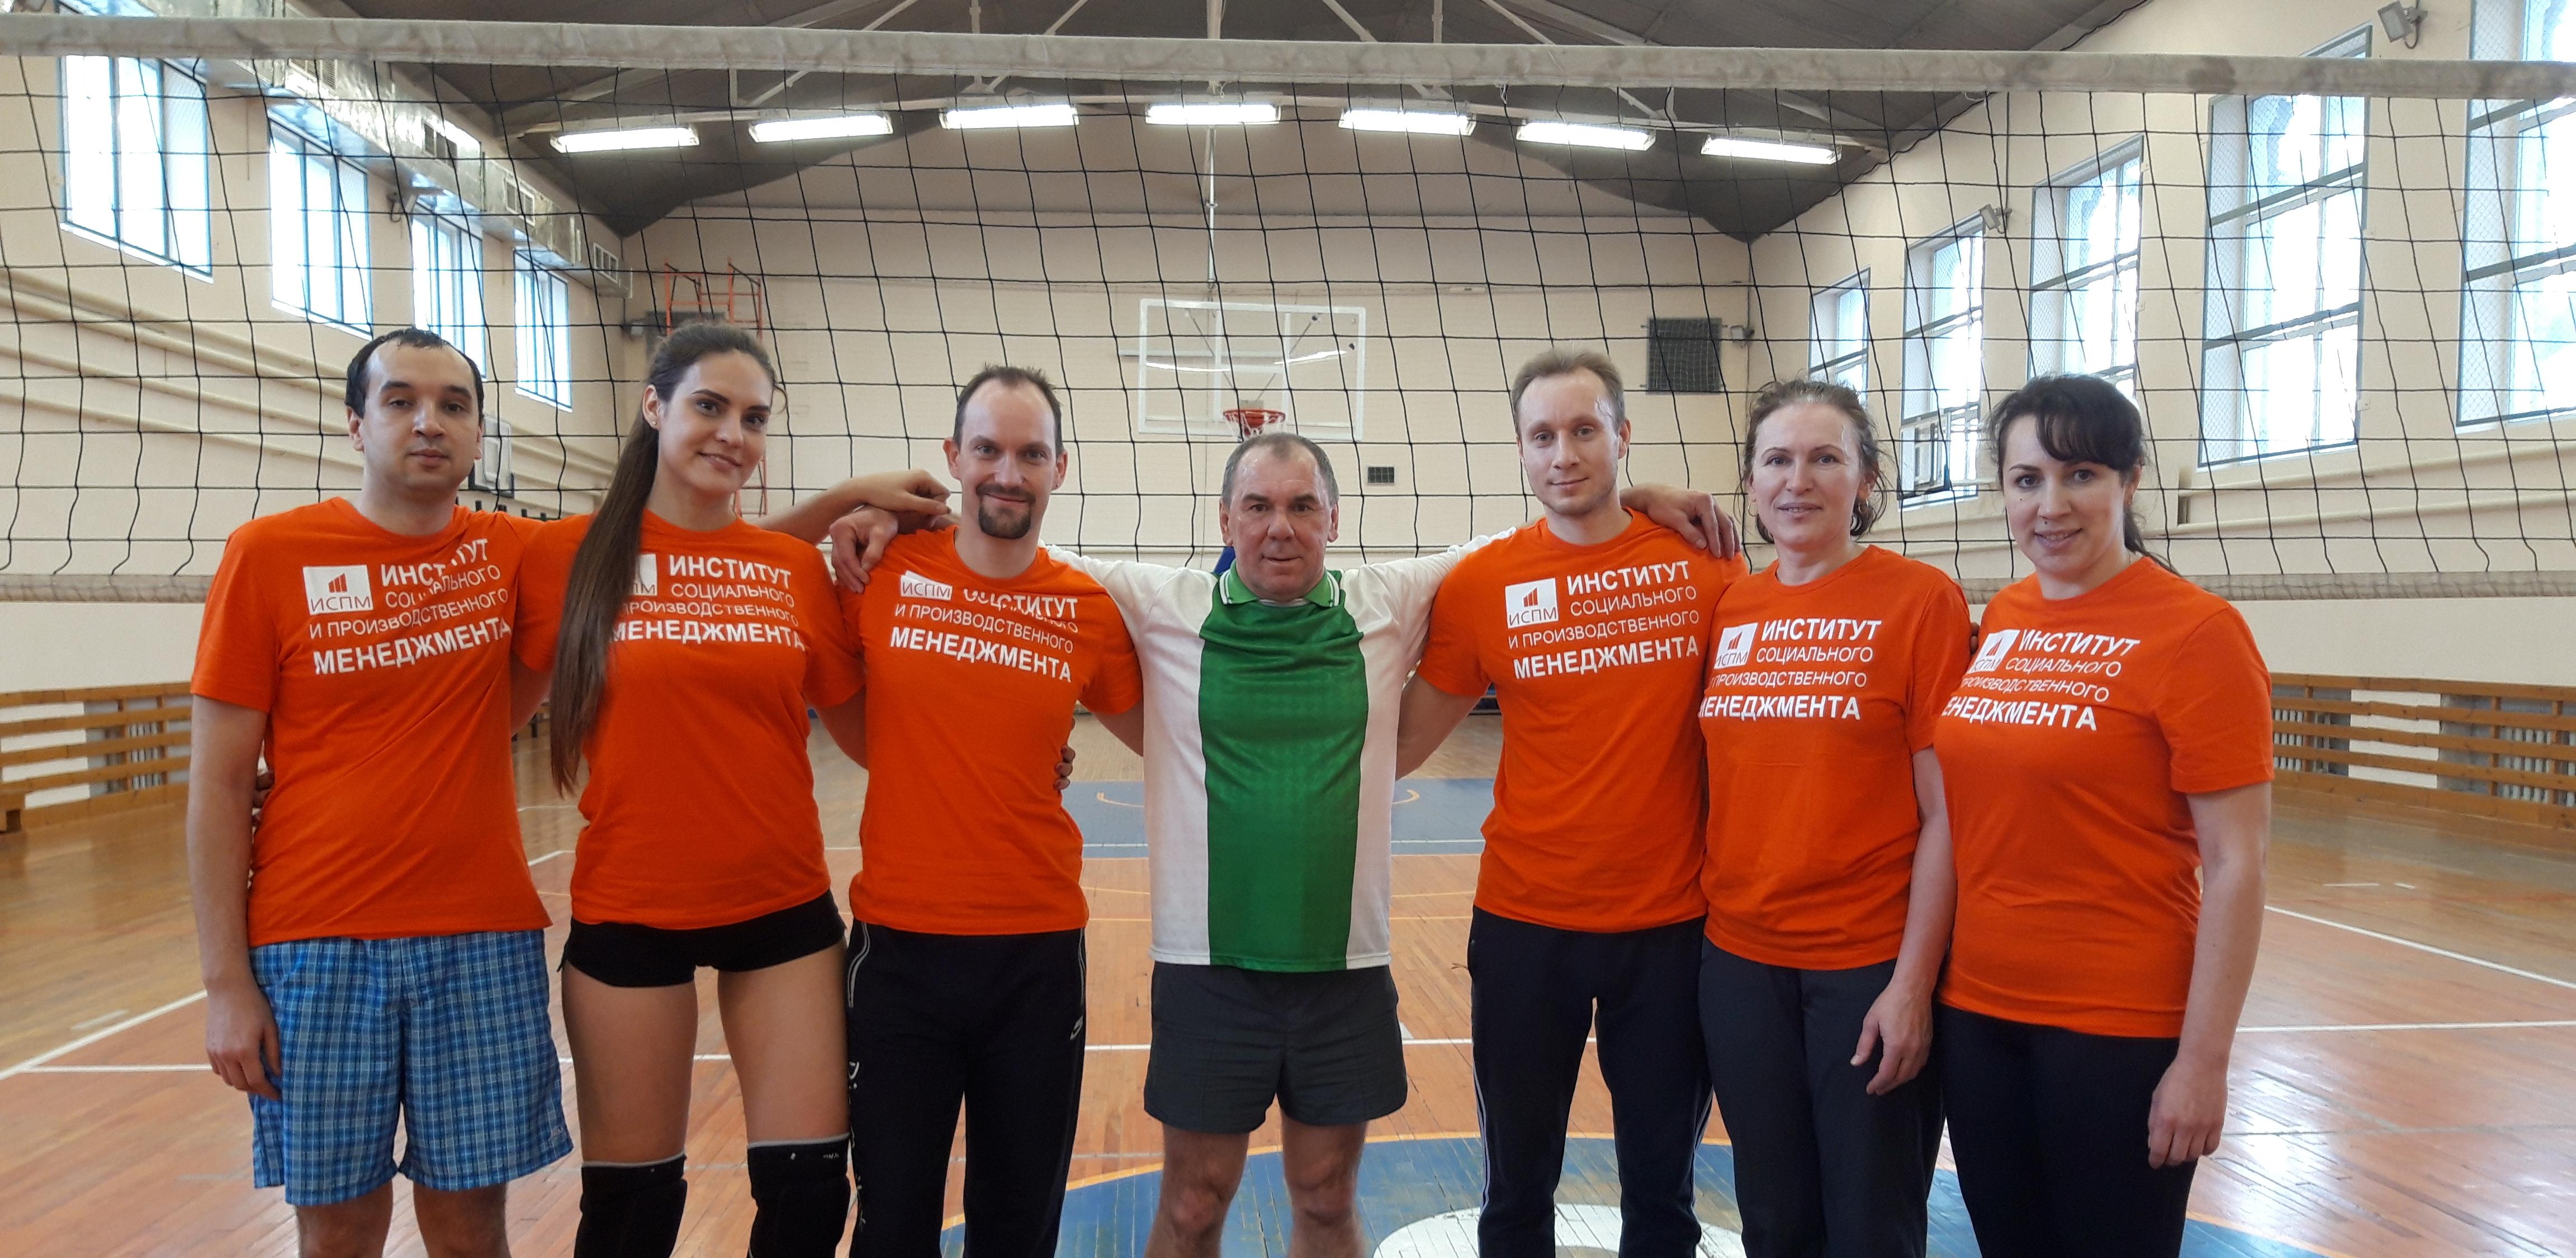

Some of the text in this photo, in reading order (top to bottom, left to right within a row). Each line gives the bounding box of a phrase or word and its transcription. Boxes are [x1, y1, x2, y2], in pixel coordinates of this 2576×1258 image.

[381, 538, 488, 586] ИНСТТУТ
[669, 555, 792, 589] ИНСТИТУТ
[1567, 561, 1689, 596] ИНСТИТУТ
[385, 564, 501, 608] СОАЛЬНОГО
[671, 583, 795, 608] СОЦИАЛЬНОГО
[902, 581, 950, 598] ИСПМ
[1570, 585, 1697, 616] СОЦИАЛЬНОГО
[309, 588, 509, 639] И ПРОИЗВОДСТВЕННОГО
[311, 596, 371, 611] ИСПМ
[1509, 607, 1557, 625] ИСПМ
[895, 603, 906, 617] И
[910, 604, 1074, 653] ПРОИЗВОДСТВЕННОГО
[1508, 610, 1699, 650] И ПРОИЗВОДСТВЕННОГО
[1761, 618, 1882, 641] ИНСТИТУТ
[2019, 628, 2141, 657] ИНСТИТУТ
[313, 617, 512, 675] МЕНЕДЖМЕНТА
[890, 626, 1072, 683] МЕНЕДЖМЕНТА
[1513, 635, 1699, 680] МЕНЕДЖМЕНТА
[1756, 646, 1873, 665] СОЦИАЛЬНОГО
[2005, 657, 2122, 678] СОЦИАЛЬНОГО
[1960, 676, 2110, 702] РОИЗВОДСТВЕННОГО
[1940, 695, 2097, 732] ЕНЕДЖМЕНТА
